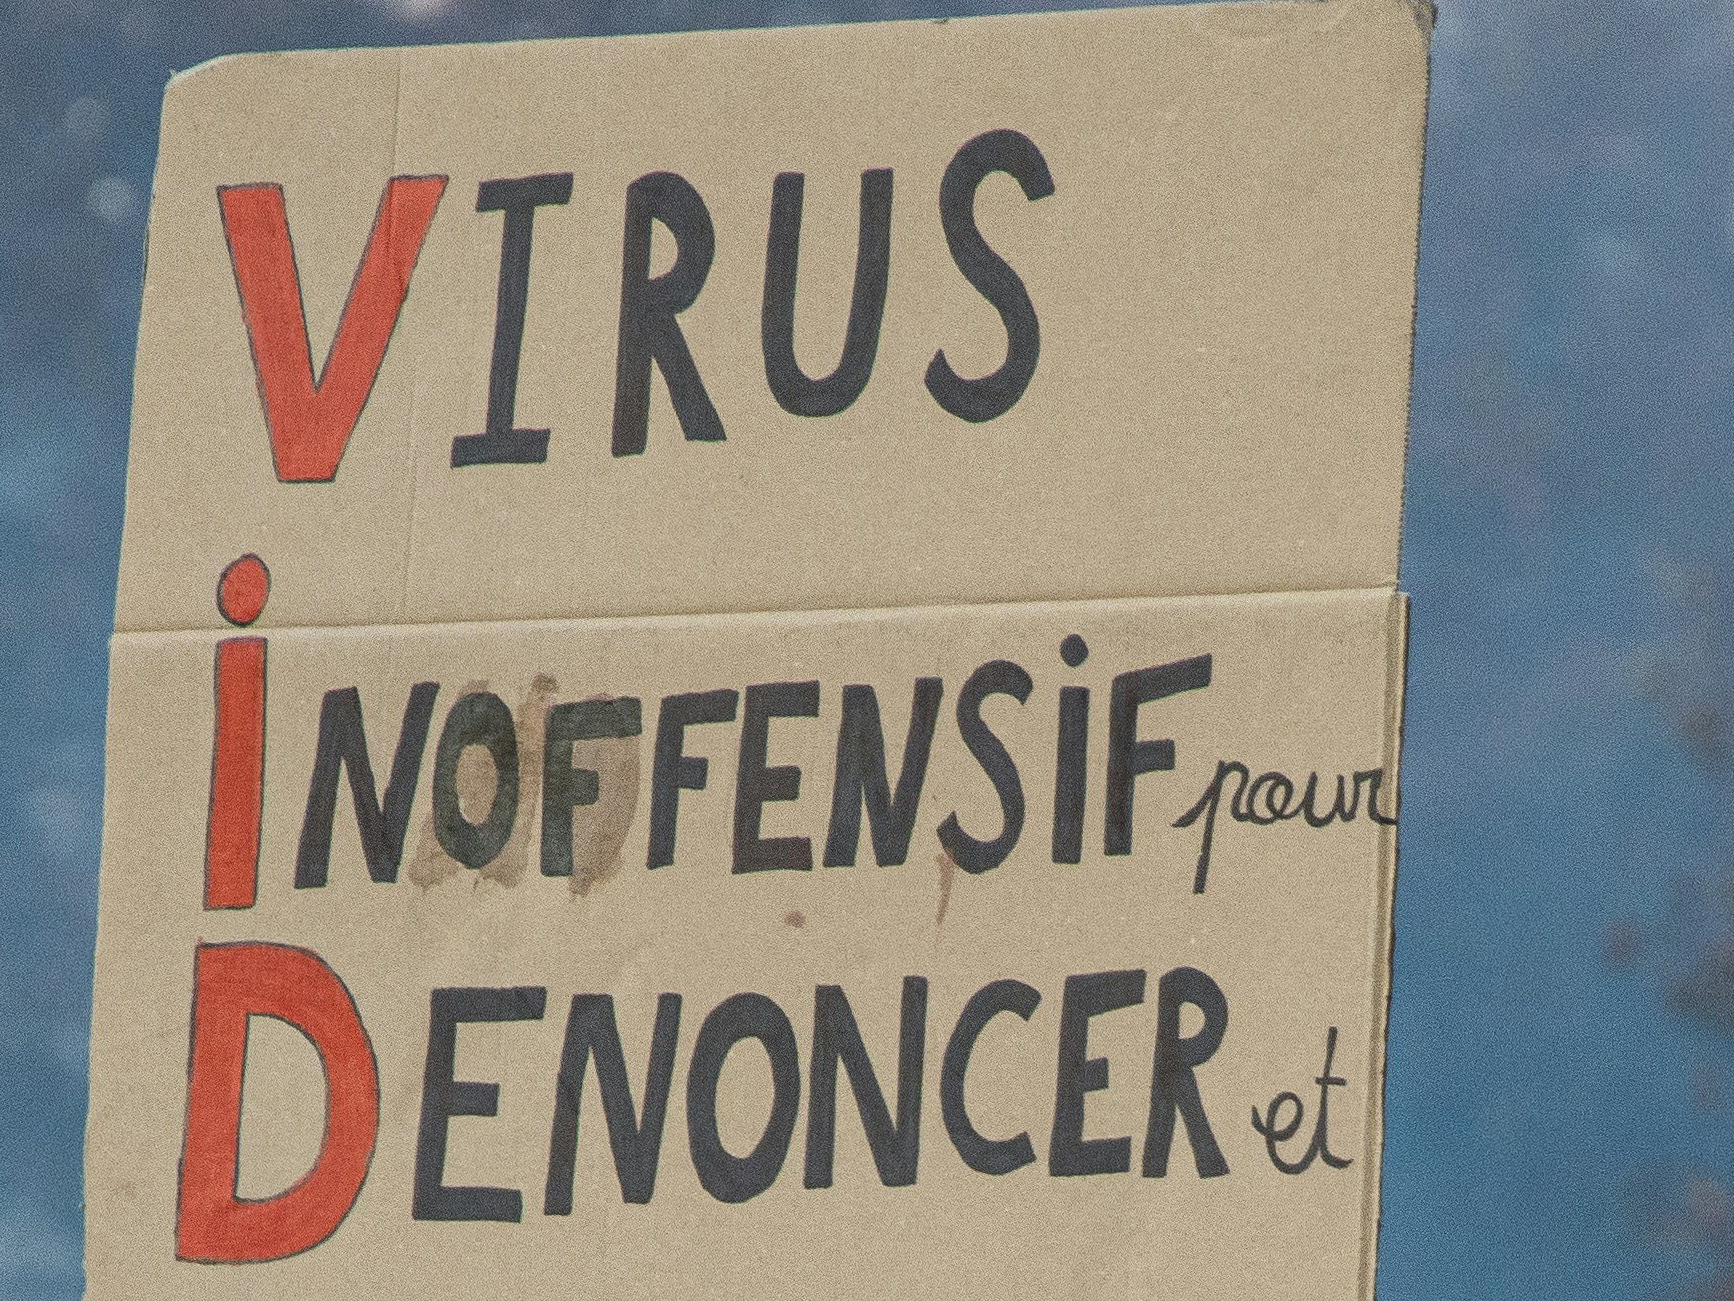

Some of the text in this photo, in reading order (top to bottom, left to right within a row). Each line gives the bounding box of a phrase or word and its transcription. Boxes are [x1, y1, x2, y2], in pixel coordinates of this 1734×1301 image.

[216, 128, 1056, 483] VIRUS
[1171, 759, 1398, 895] pour
[174, 941, 1354, 1264] DENONCER et
